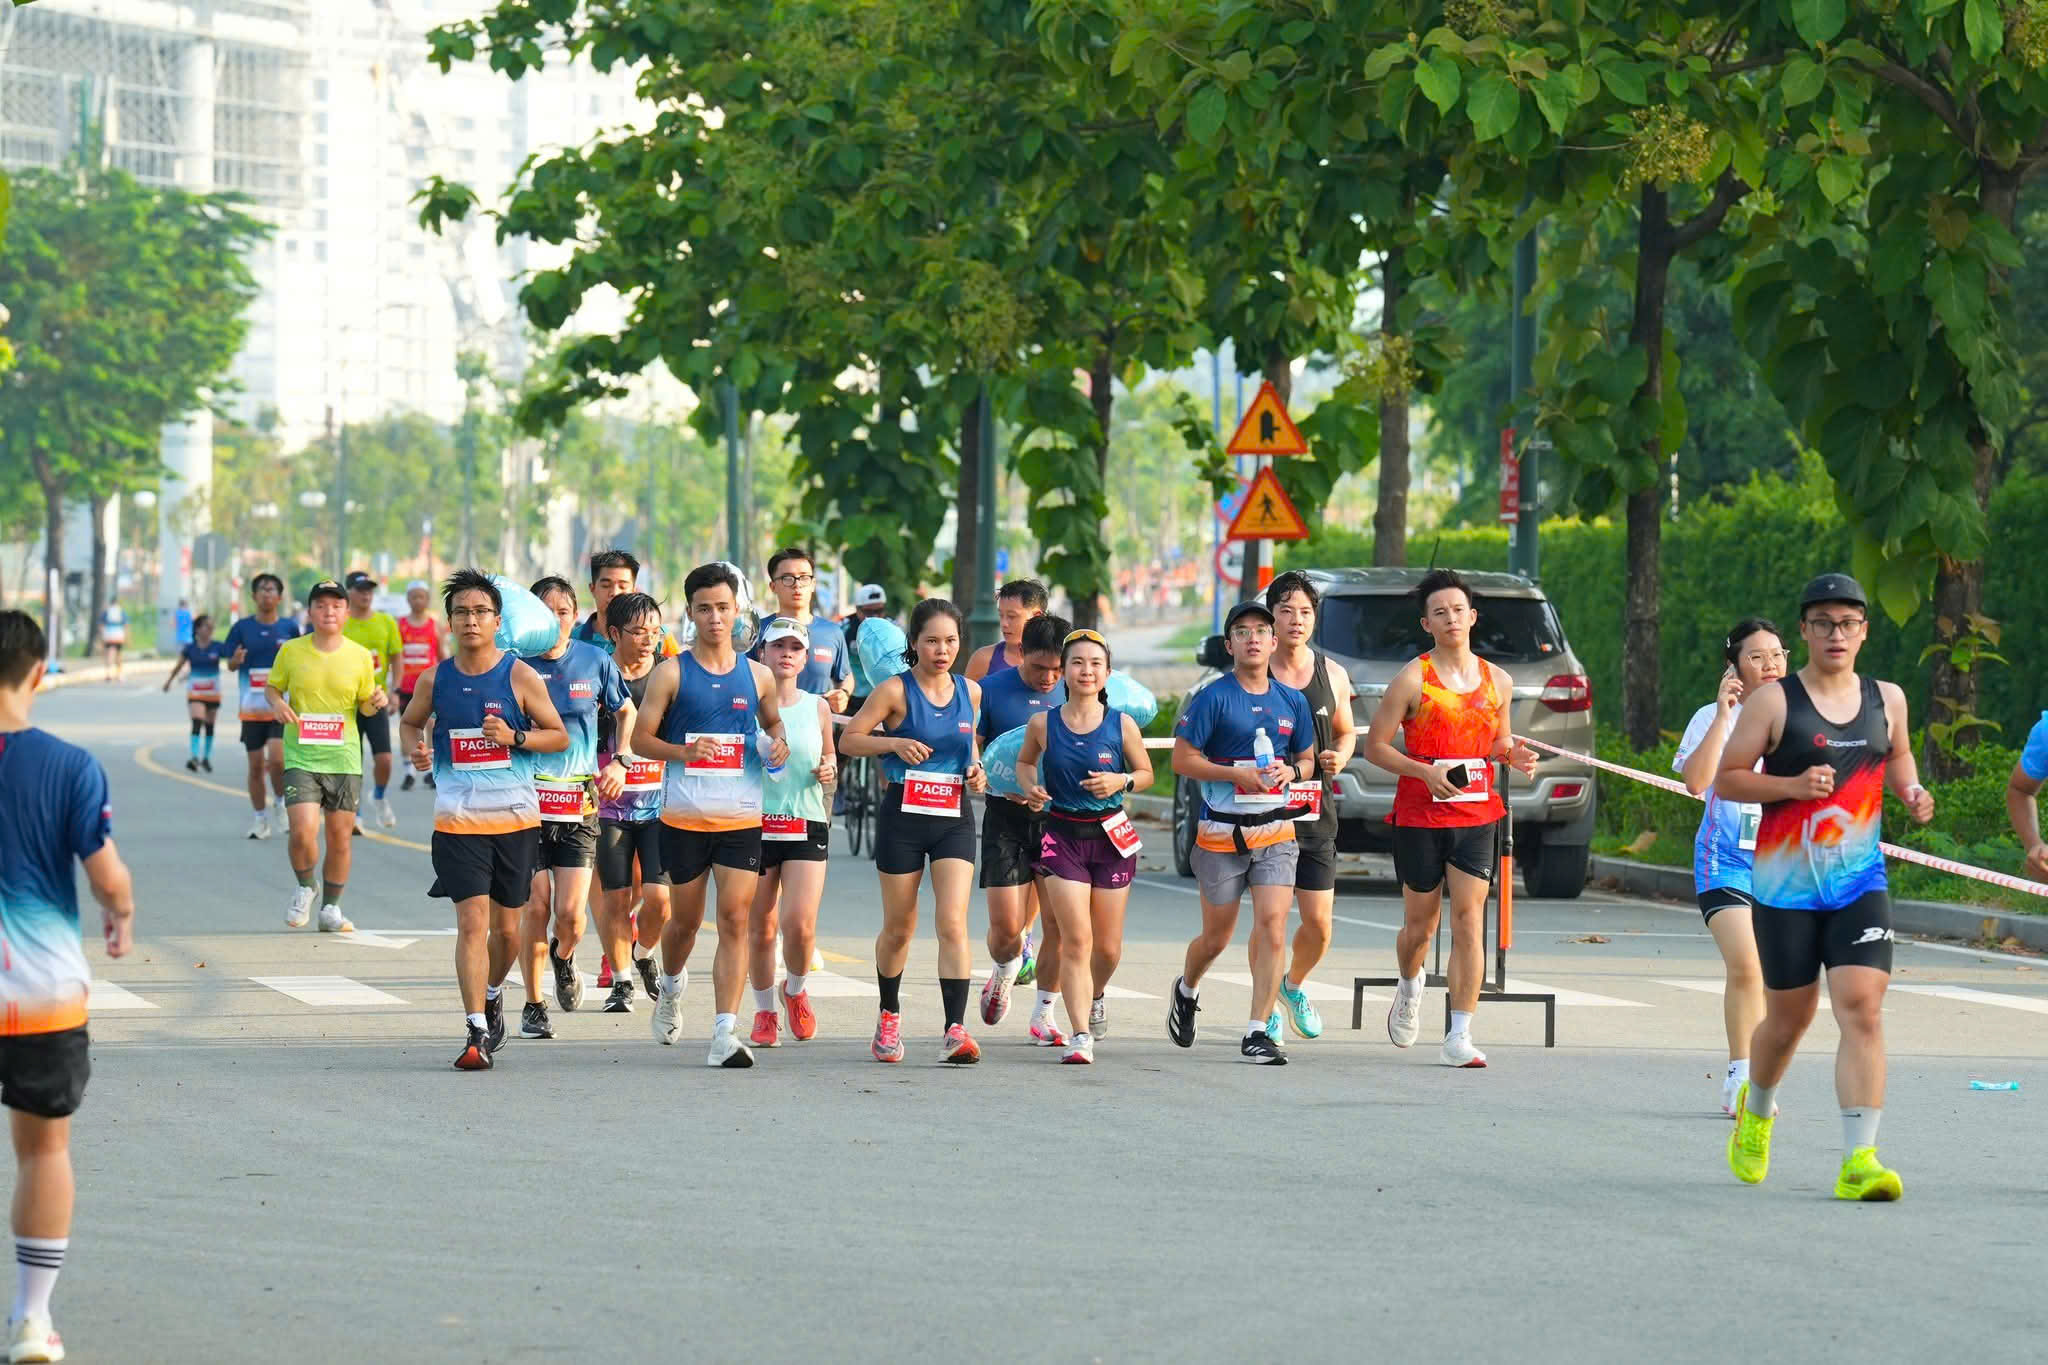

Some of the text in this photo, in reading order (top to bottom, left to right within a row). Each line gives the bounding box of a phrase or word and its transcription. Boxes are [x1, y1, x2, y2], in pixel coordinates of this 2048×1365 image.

[303, 722, 340, 731] M20597
[628, 763, 660, 773] 20146
[914, 783, 953, 796] PACER
[537, 791, 577, 803] M20601
[1289, 791, 1315, 801] 0065
